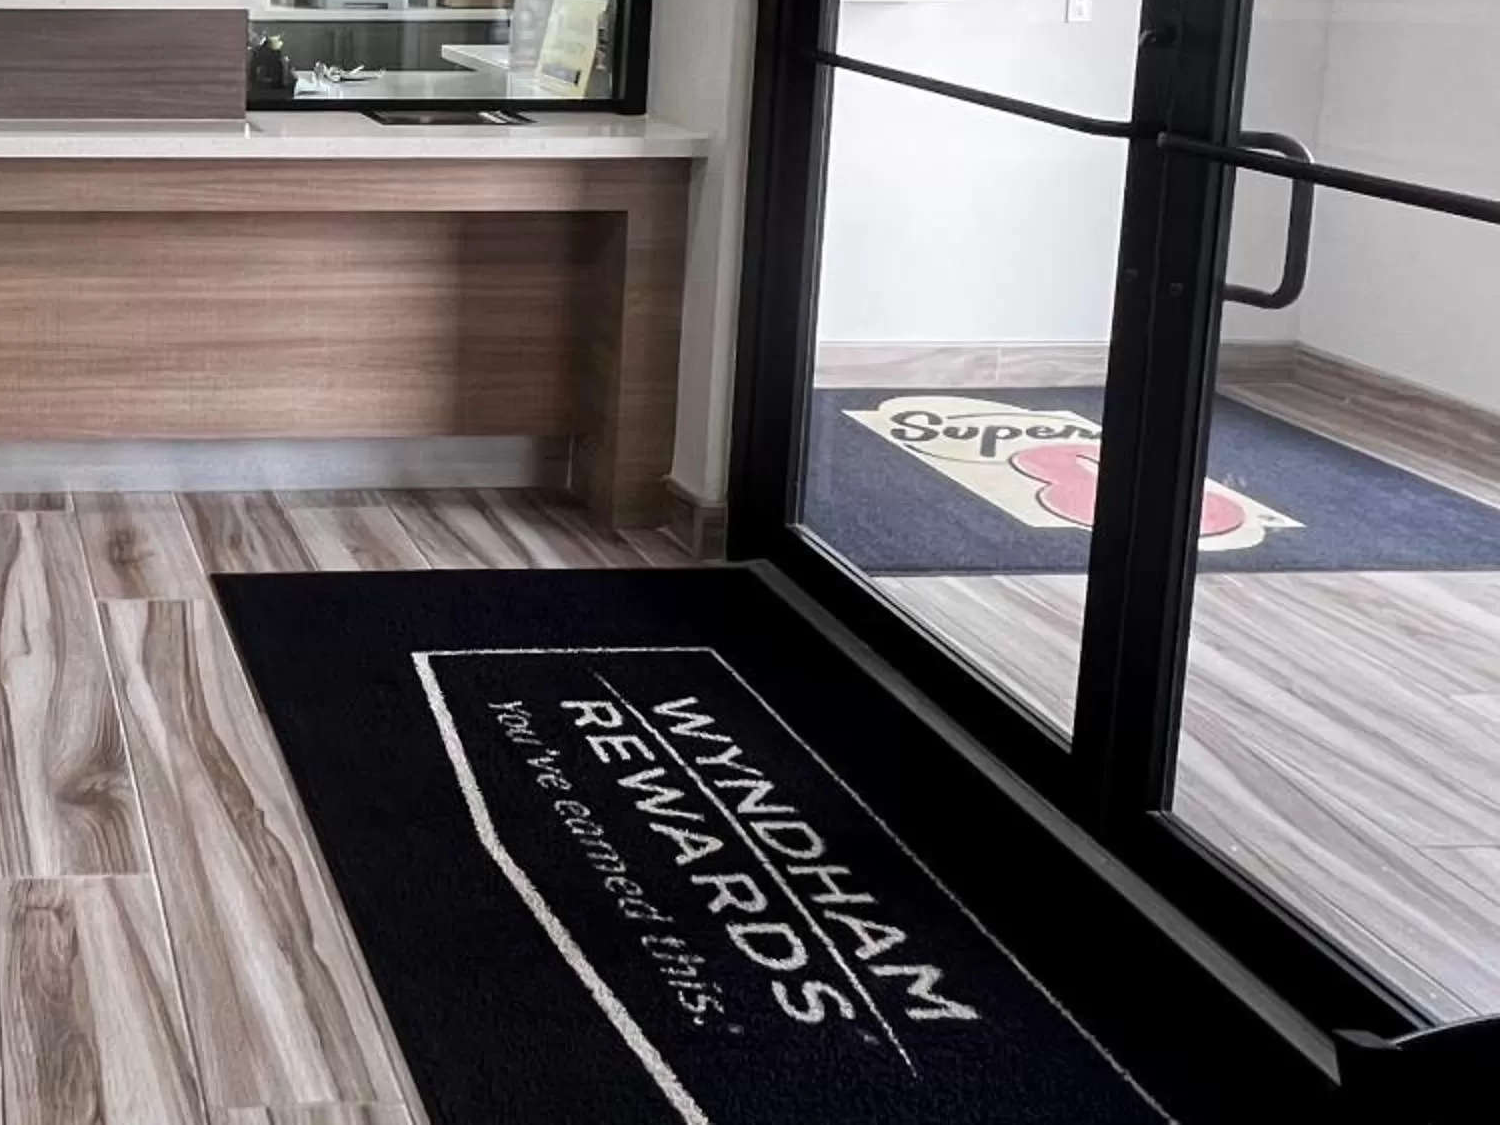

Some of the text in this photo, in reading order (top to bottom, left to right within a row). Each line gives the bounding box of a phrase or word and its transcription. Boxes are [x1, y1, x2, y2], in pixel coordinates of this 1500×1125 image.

[890, 410, 1101, 458] Super
[554, 799, 676, 923] earned
[560, 698, 856, 1025] REWARDS
[652, 696, 982, 1022] WYNDHAM
